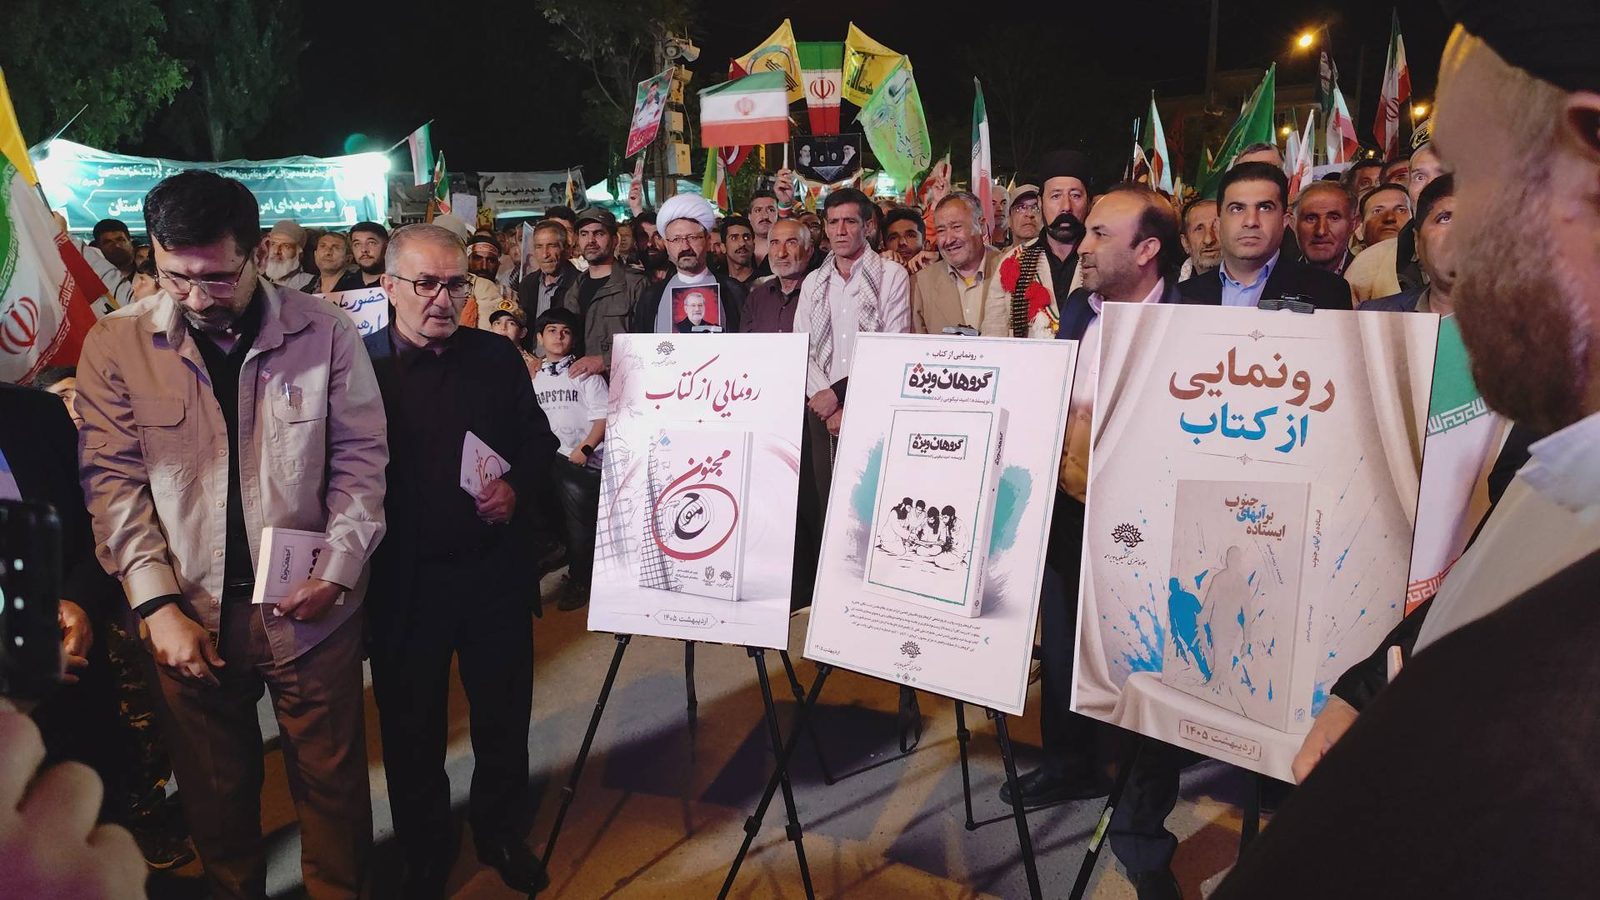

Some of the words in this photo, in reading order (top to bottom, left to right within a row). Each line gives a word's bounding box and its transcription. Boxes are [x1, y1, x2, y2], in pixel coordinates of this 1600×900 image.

[107, 197, 144, 216] استان
[352, 290, 386, 313] حضور
[932, 350, 948, 358] کتاب
[953, 350, 976, 360] رونمایی
[645, 354, 720, 410] کتاب
[908, 362, 938, 395] ویژه
[937, 368, 993, 392] گروهان
[1168, 346, 1337, 413] رونمایی
[694, 378, 712, 401] از
[712, 373, 761, 418] رونمایی
[1179, 402, 1278, 445] کتاب
[1275, 413, 1309, 453] از
[911, 433, 930, 453] ویژه
[930, 437, 964, 452] گروهان
[1224, 493, 1259, 512] جنوب
[1236, 504, 1267, 523] آبهای
[1262, 512, 1274, 524] بر
[1246, 523, 1286, 541] ایستاده
[679, 616, 709, 626] اردیبهشت
[1185, 725, 1209, 740] ۱۴۰۵
[1211, 736, 1256, 755] اردیبهشت
